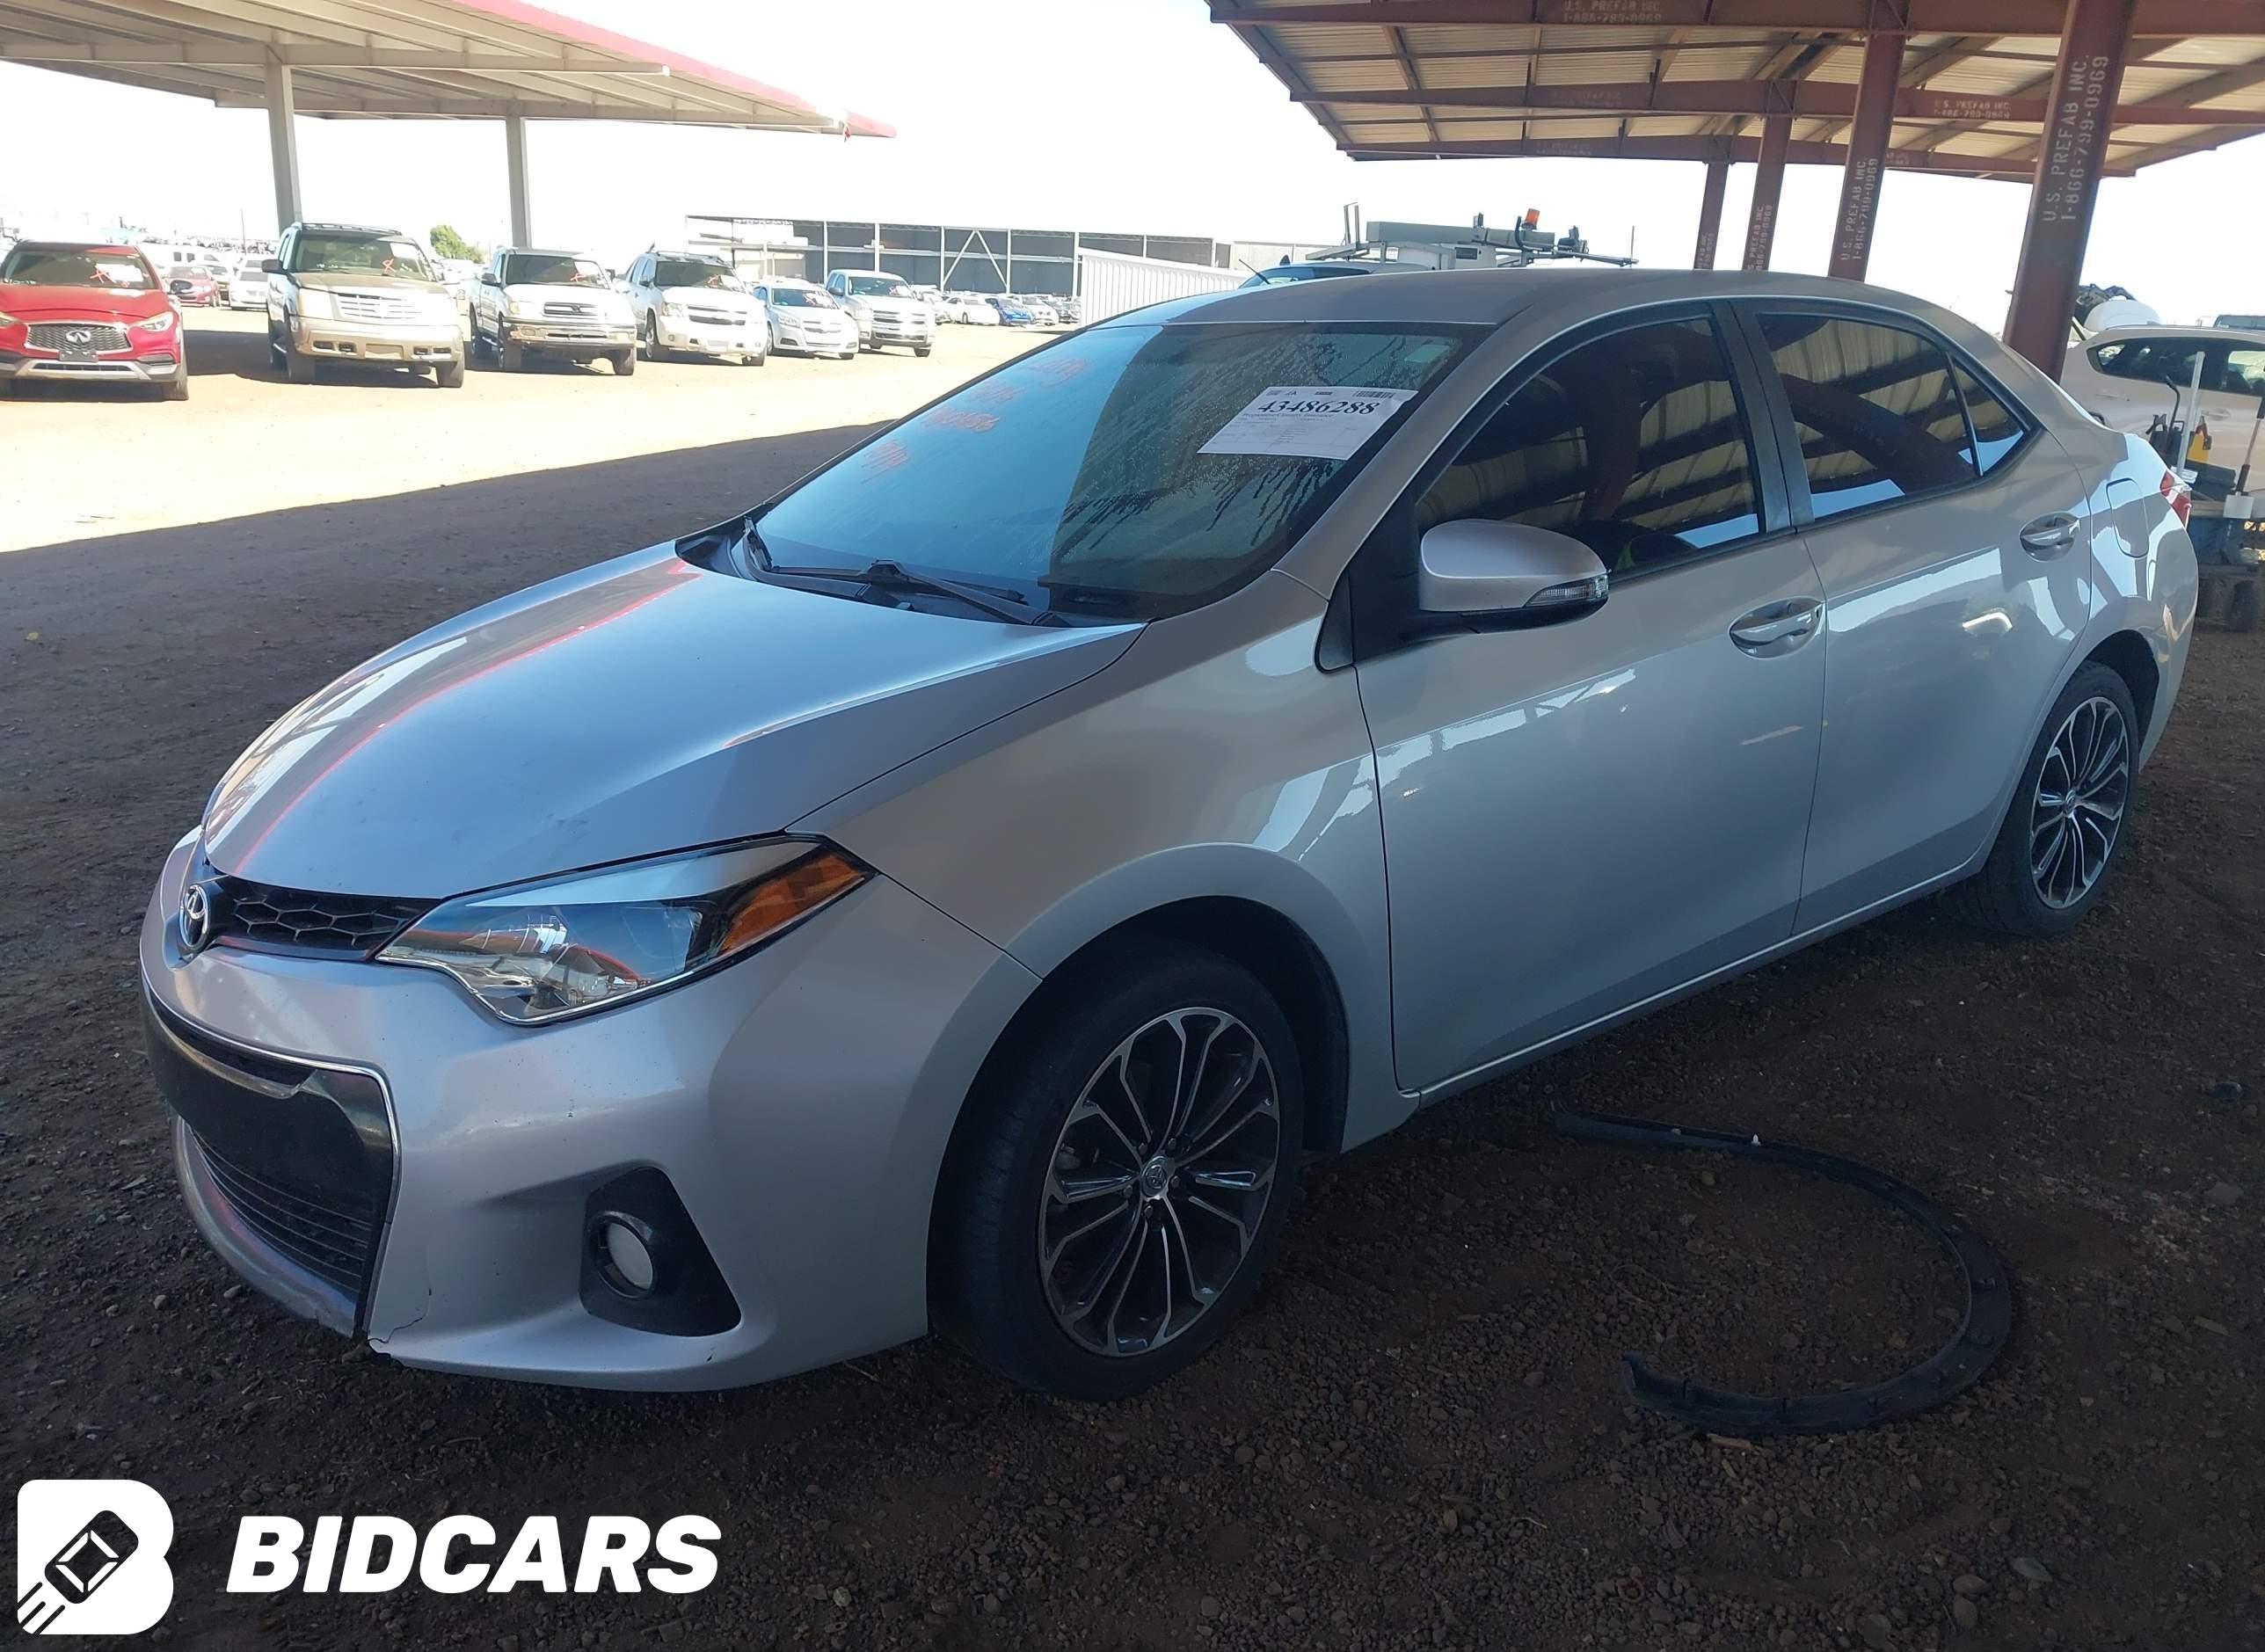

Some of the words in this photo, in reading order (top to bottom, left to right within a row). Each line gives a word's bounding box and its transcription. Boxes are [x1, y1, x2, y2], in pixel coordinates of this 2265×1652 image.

[2068, 55, 2089, 91] INC.
[2050, 102, 2079, 176] PREFAB
[2060, 55, 2109, 221] 1-866-799-0969
[1846, 186, 1862, 233] PREFAB
[2042, 187, 2064, 222] U.S.
[1257, 399, 1380, 415] 43486288
